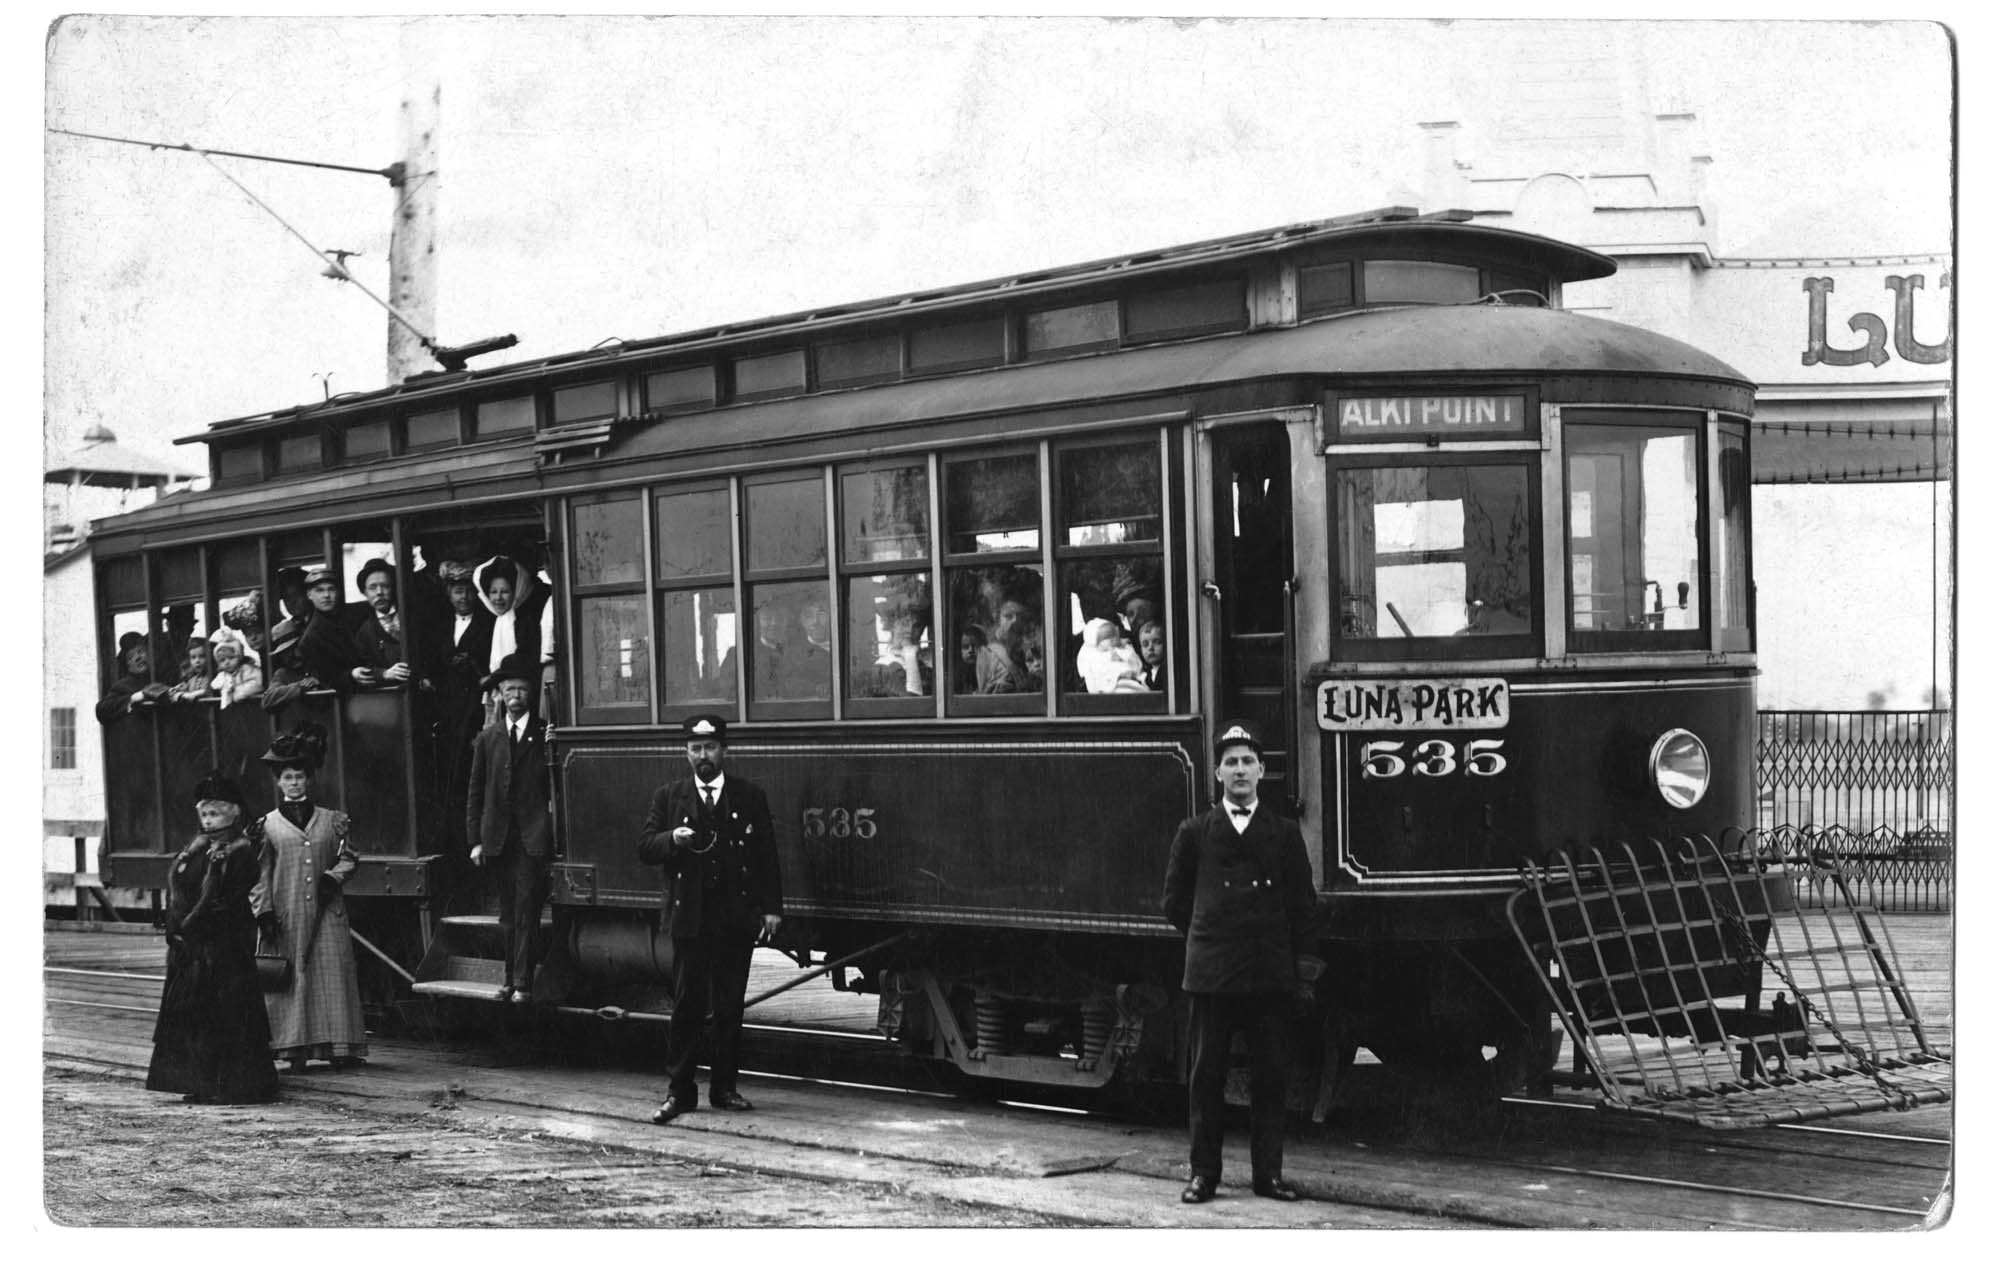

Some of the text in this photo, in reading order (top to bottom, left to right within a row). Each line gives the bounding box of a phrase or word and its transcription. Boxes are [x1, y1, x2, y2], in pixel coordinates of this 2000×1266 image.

[1802, 274, 1950, 368] LU
[1342, 398, 1411, 426] ALKI
[1323, 684, 1504, 725] LUNA PARK
[1361, 739, 1507, 779] 535
[803, 808, 877, 838] 535
